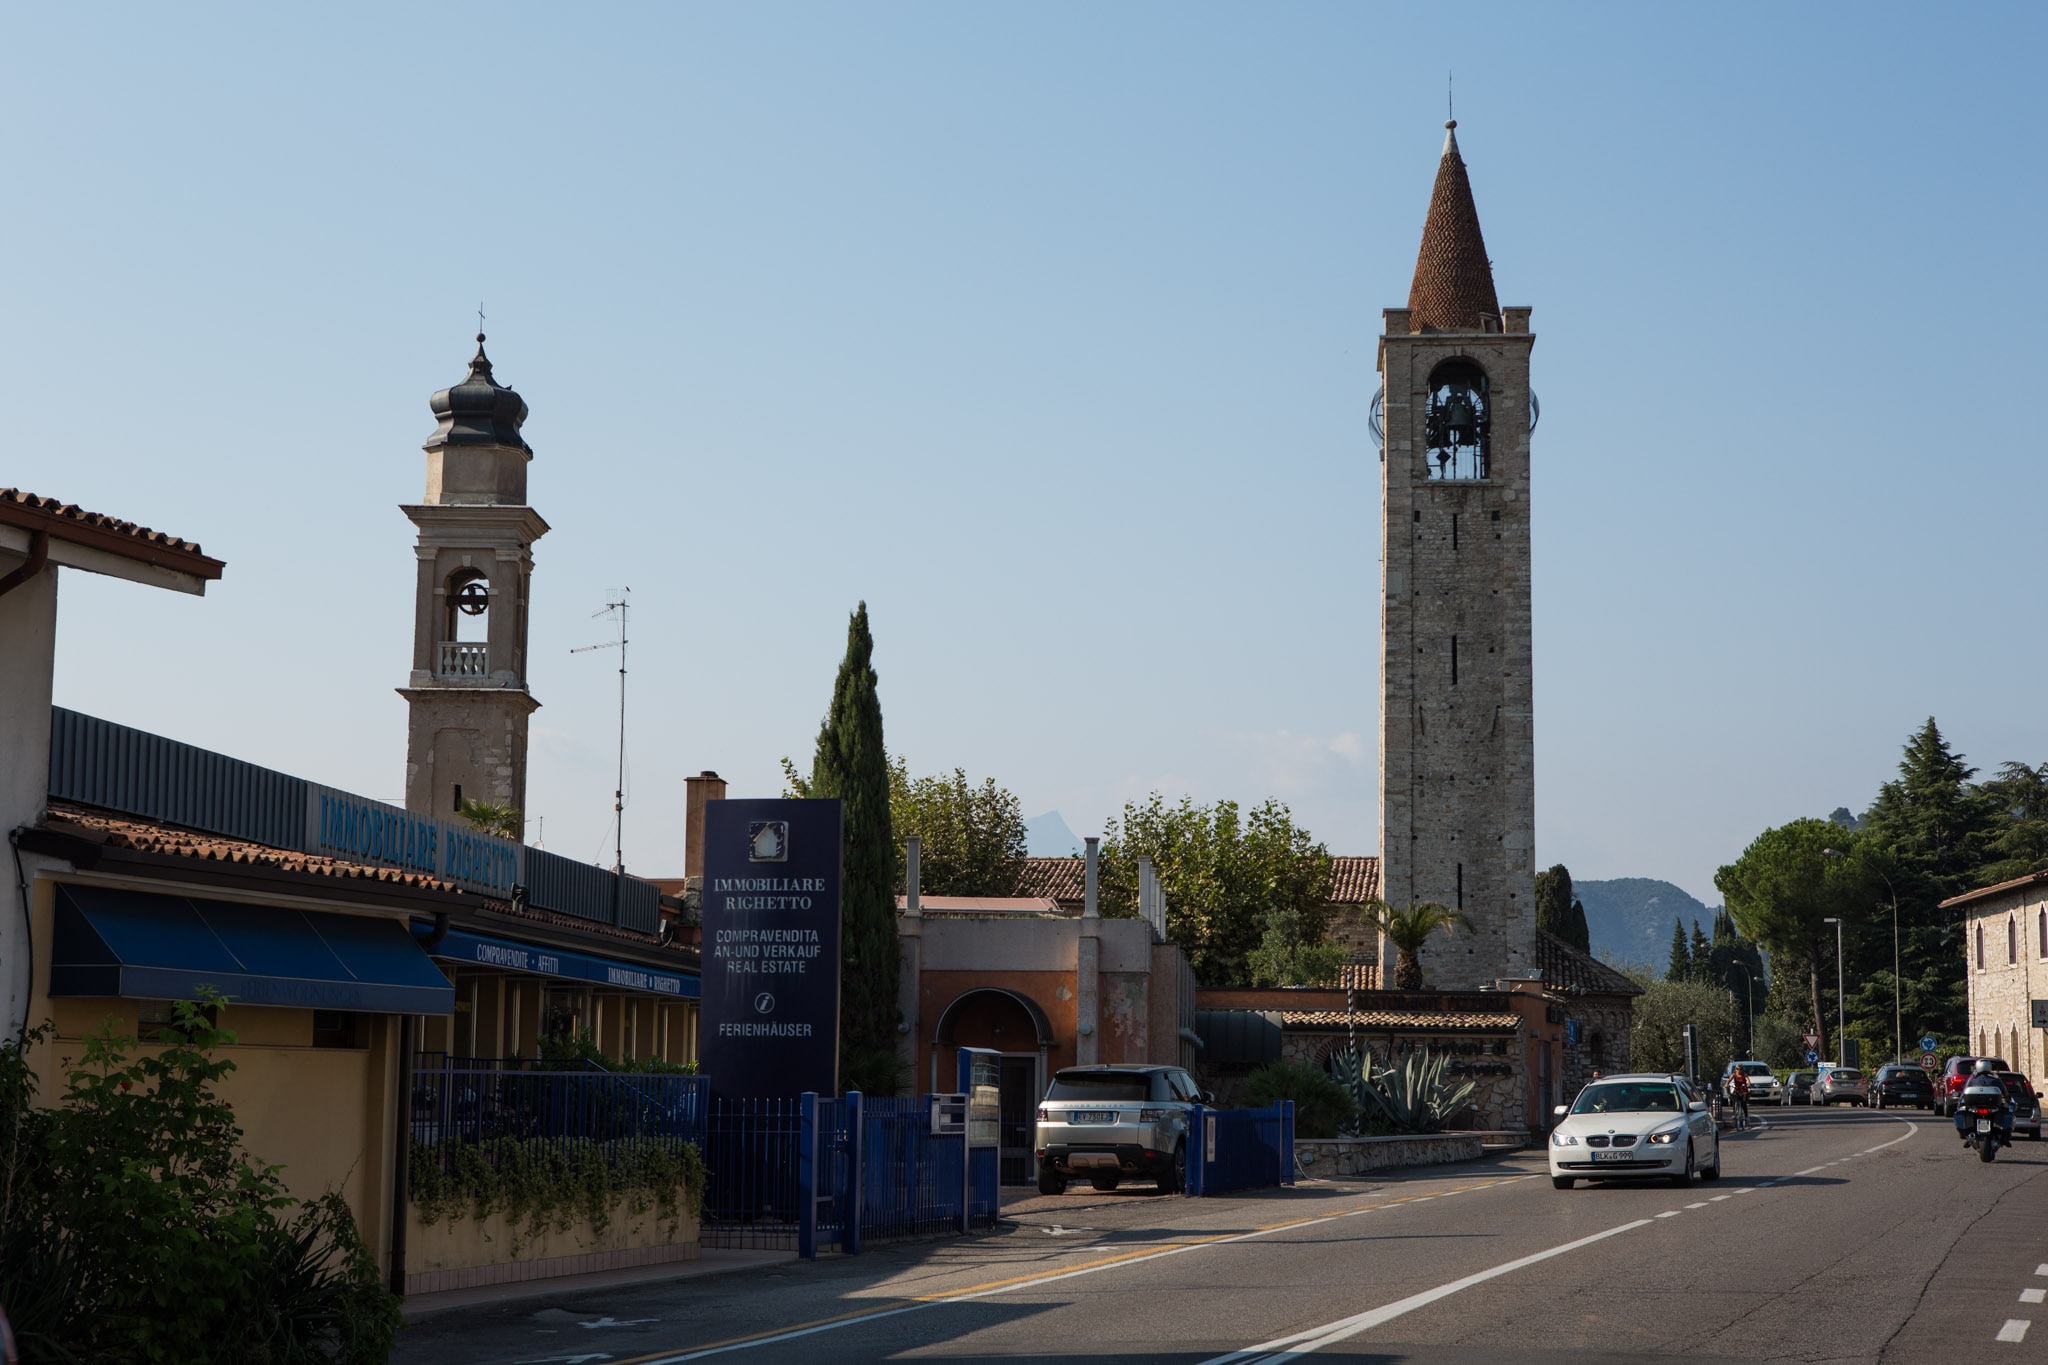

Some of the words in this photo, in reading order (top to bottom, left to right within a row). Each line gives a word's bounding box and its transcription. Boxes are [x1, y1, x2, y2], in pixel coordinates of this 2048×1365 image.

[319, 795, 437, 874] IMMOBILIARE
[446, 831, 518, 891] RIGHETTO
[714, 878, 825, 892] IMMOBILIARE
[725, 896, 812, 910] RIGHETTO
[716, 929, 819, 943] COMPRAVENDITA
[477, 943, 528, 969] COMPRAVENDITE
[537, 954, 559, 974] AFFITTI
[714, 945, 760, 959] AN-UND
[763, 945, 821, 958] VERKAUF
[727, 960, 758, 973] REAL
[761, 960, 806, 973] ESTATE
[608, 966, 648, 989] IMMOBILIARE
[653, 975, 681, 994] RIGHETTO
[719, 1021, 812, 1037] FERIENHÄUSER
[1923, 1057, 1934, 1065] 30
[1596, 1152, 1609, 1160] BLK
[1619, 1152, 1632, 1160] 999
